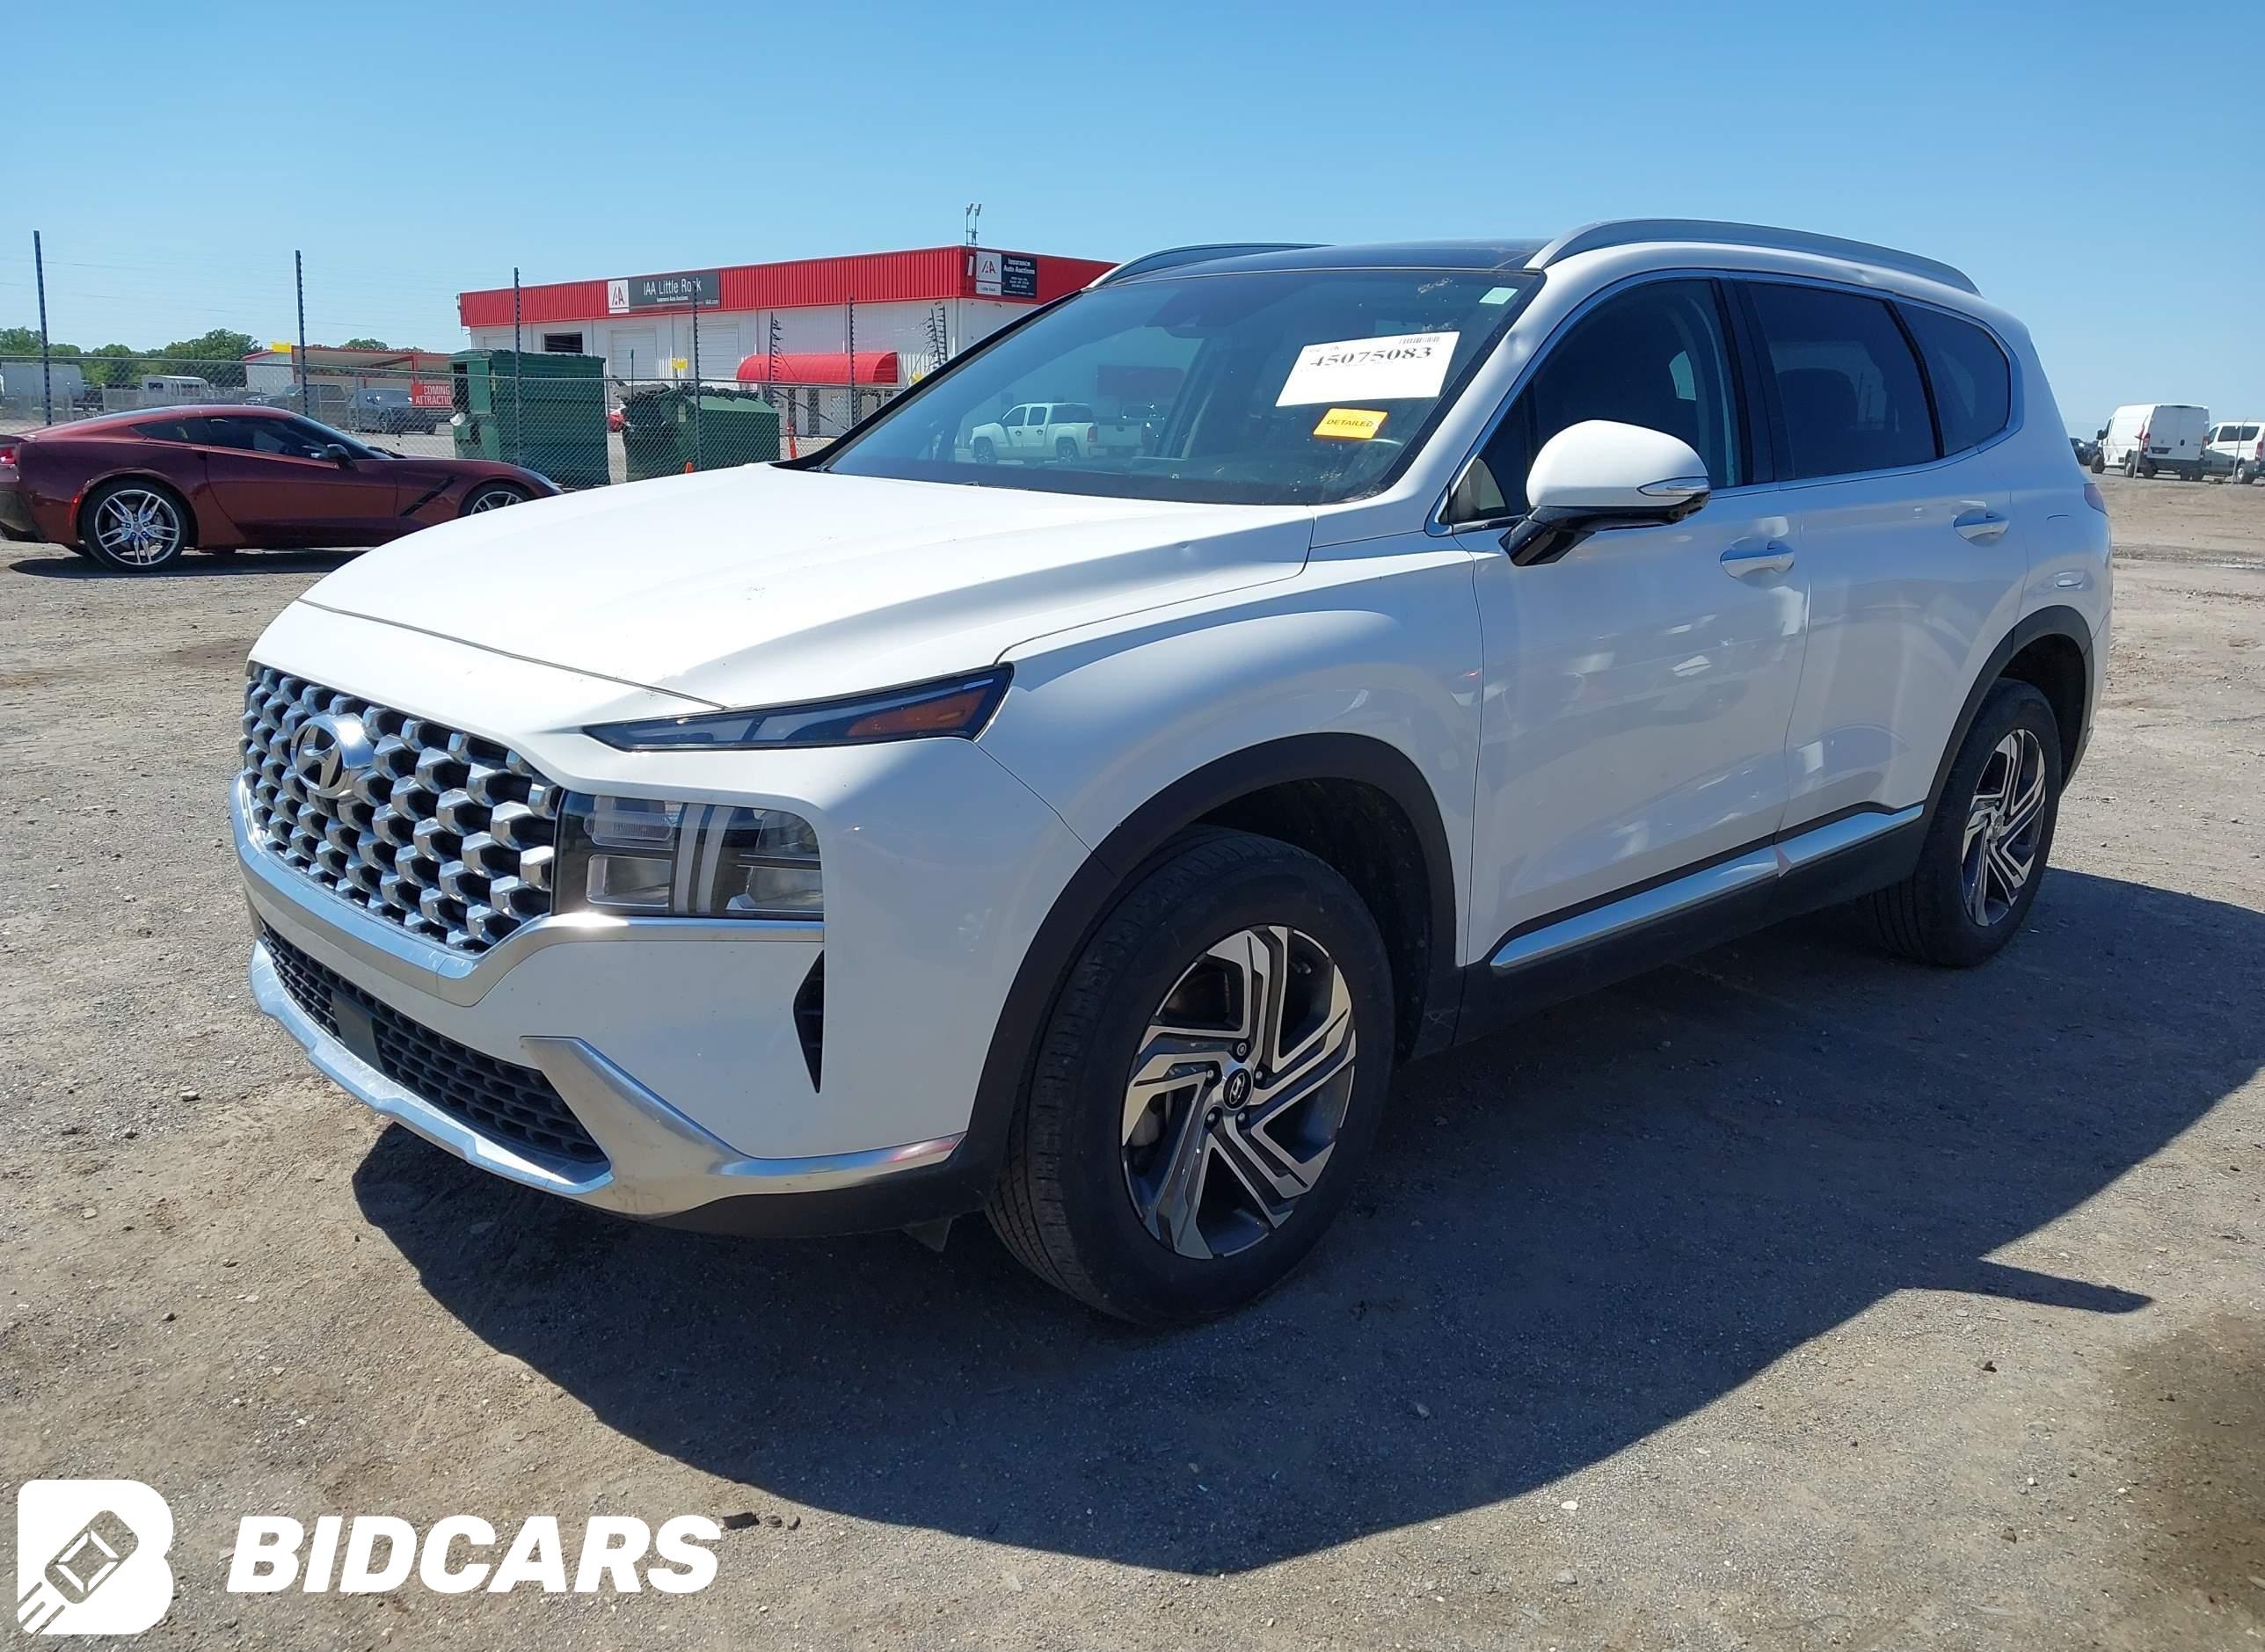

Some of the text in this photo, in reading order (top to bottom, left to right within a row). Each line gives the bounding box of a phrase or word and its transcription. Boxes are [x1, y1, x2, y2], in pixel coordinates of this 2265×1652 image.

[1008, 258, 1031, 266] Insurance
[643, 281, 656, 295] IAA
[659, 279, 679, 295] Little
[1310, 346, 1432, 367] 45075083
[423, 385, 450, 395] COMING
[1326, 418, 1374, 428] DETAILED
